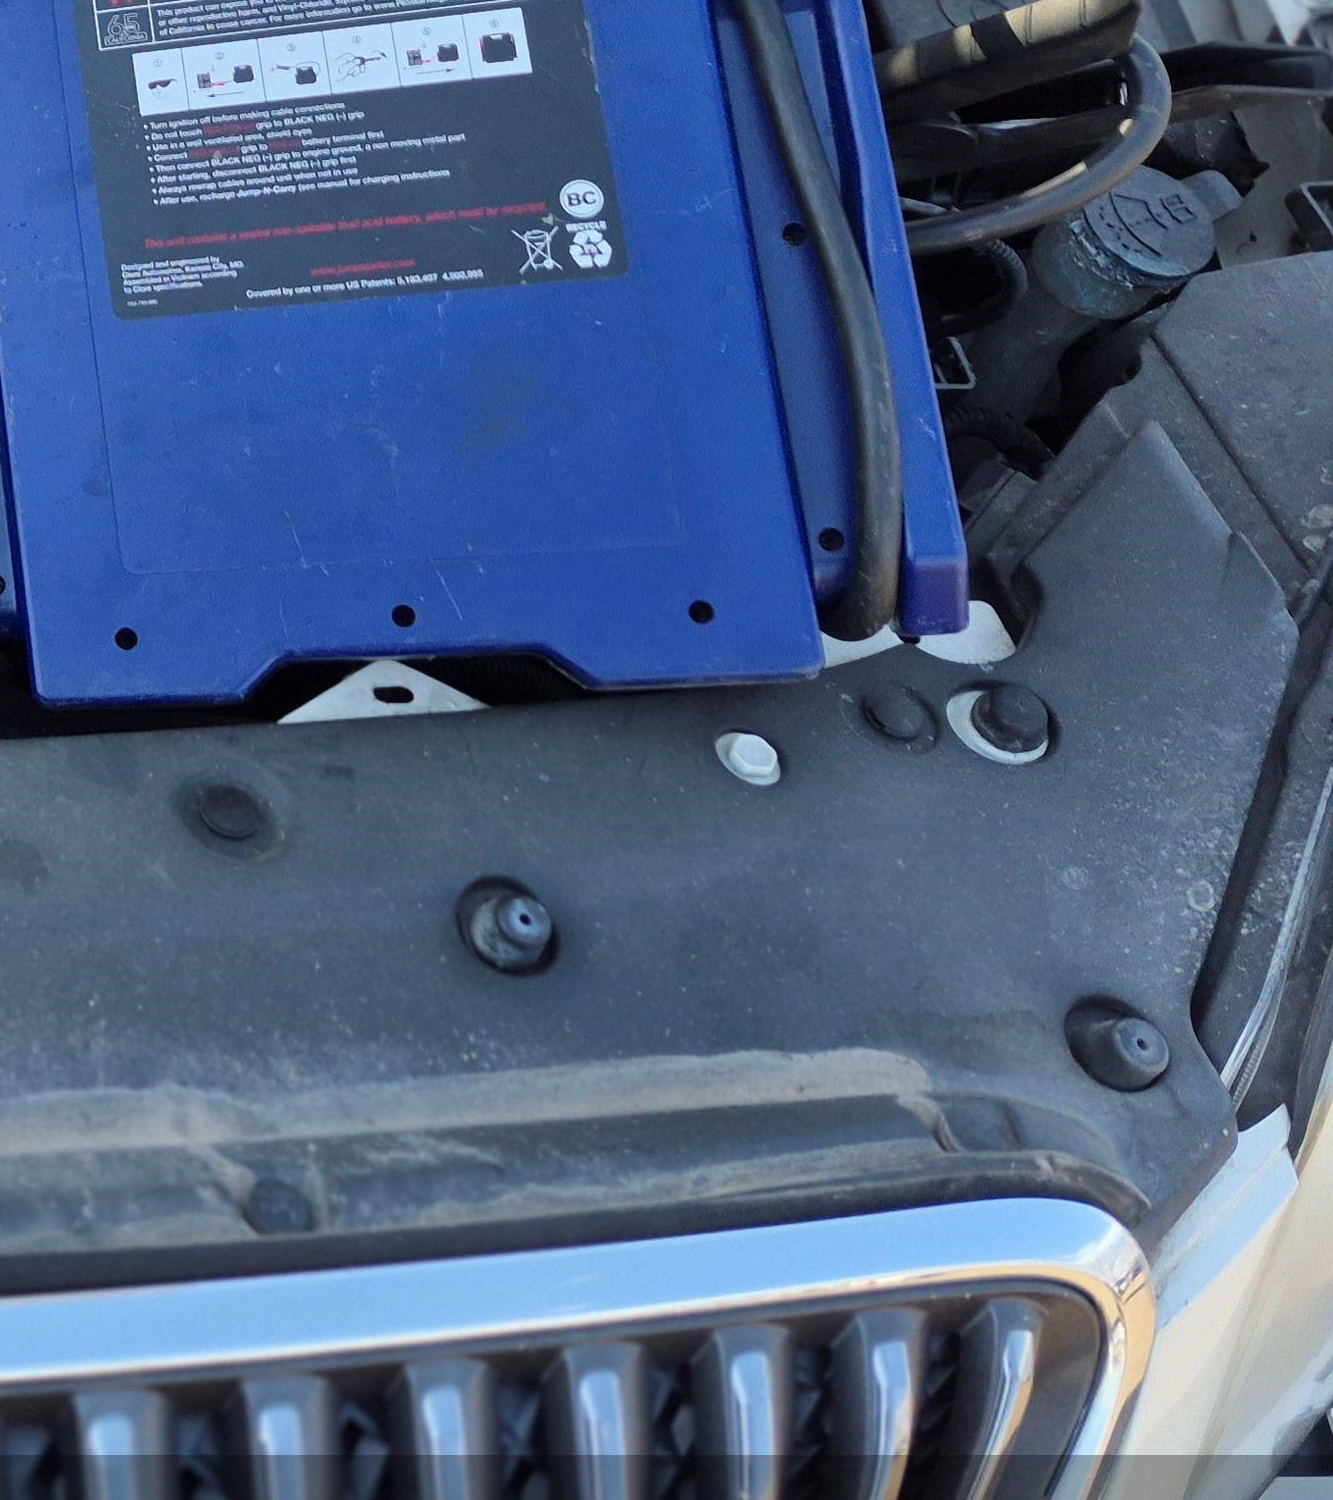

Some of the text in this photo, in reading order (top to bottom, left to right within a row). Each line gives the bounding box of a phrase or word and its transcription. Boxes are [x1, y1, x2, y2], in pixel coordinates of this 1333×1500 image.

[174, 5, 203, 15] product
[220, 0, 247, 8] expose
[151, 132, 163, 140] Do
[179, 128, 202, 137] touch
[255, 121, 272, 130] grip
[284, 116, 313, 125] BLACK
[315, 113, 334, 121] NEG
[347, 111, 364, 120] grip
[169, 119, 198, 128] ignition
[199, 116, 210, 124] off
[212, 114, 238, 122] before
[239, 111, 269, 119] making
[271, 107, 293, 115] cable
[294, 103, 345, 113] connections
[153, 152, 187, 161] Connect
[240, 145, 257, 153] grip
[301, 137, 330, 145] battery
[332, 132, 365, 142] terminal
[367, 130, 384, 138] first
[186, 139, 202, 147] well
[203, 134, 243, 145] ventilated
[266, 129, 291, 138] shield
[292, 128, 312, 136] eyes
[177, 160, 209, 170] connect
[211, 157, 240, 166] BLACK
[242, 154, 260, 162] NEG
[274, 152, 290, 161] grip
[302, 148, 330, 157] engine
[390, 139, 421, 147] moving
[422, 135, 446, 144] metal
[448, 133, 465, 142] part
[157, 175, 176, 183] After
[212, 166, 256, 177] disconnect
[258, 163, 287, 172] BLACK
[289, 160, 308, 169] NEG
[322, 158, 338, 167] grip
[339, 156, 356, 164] first
[158, 185, 187, 193] Always
[217, 179, 244, 187] cables
[246, 175, 275, 184] around
[293, 172, 316, 180] when
[199, 191, 235, 200] recharge
[317, 179, 347, 188] manual
[362, 175, 399, 184] charging
[400, 170, 450, 180] instructions
[567, 191, 595, 206] BC
[565, 221, 606, 233] RECYCLE
[246, 287, 281, 298] Covered
[282, 287, 293, 296] by
[346, 280, 359, 289] US
[360, 278, 395, 287] Patents:
